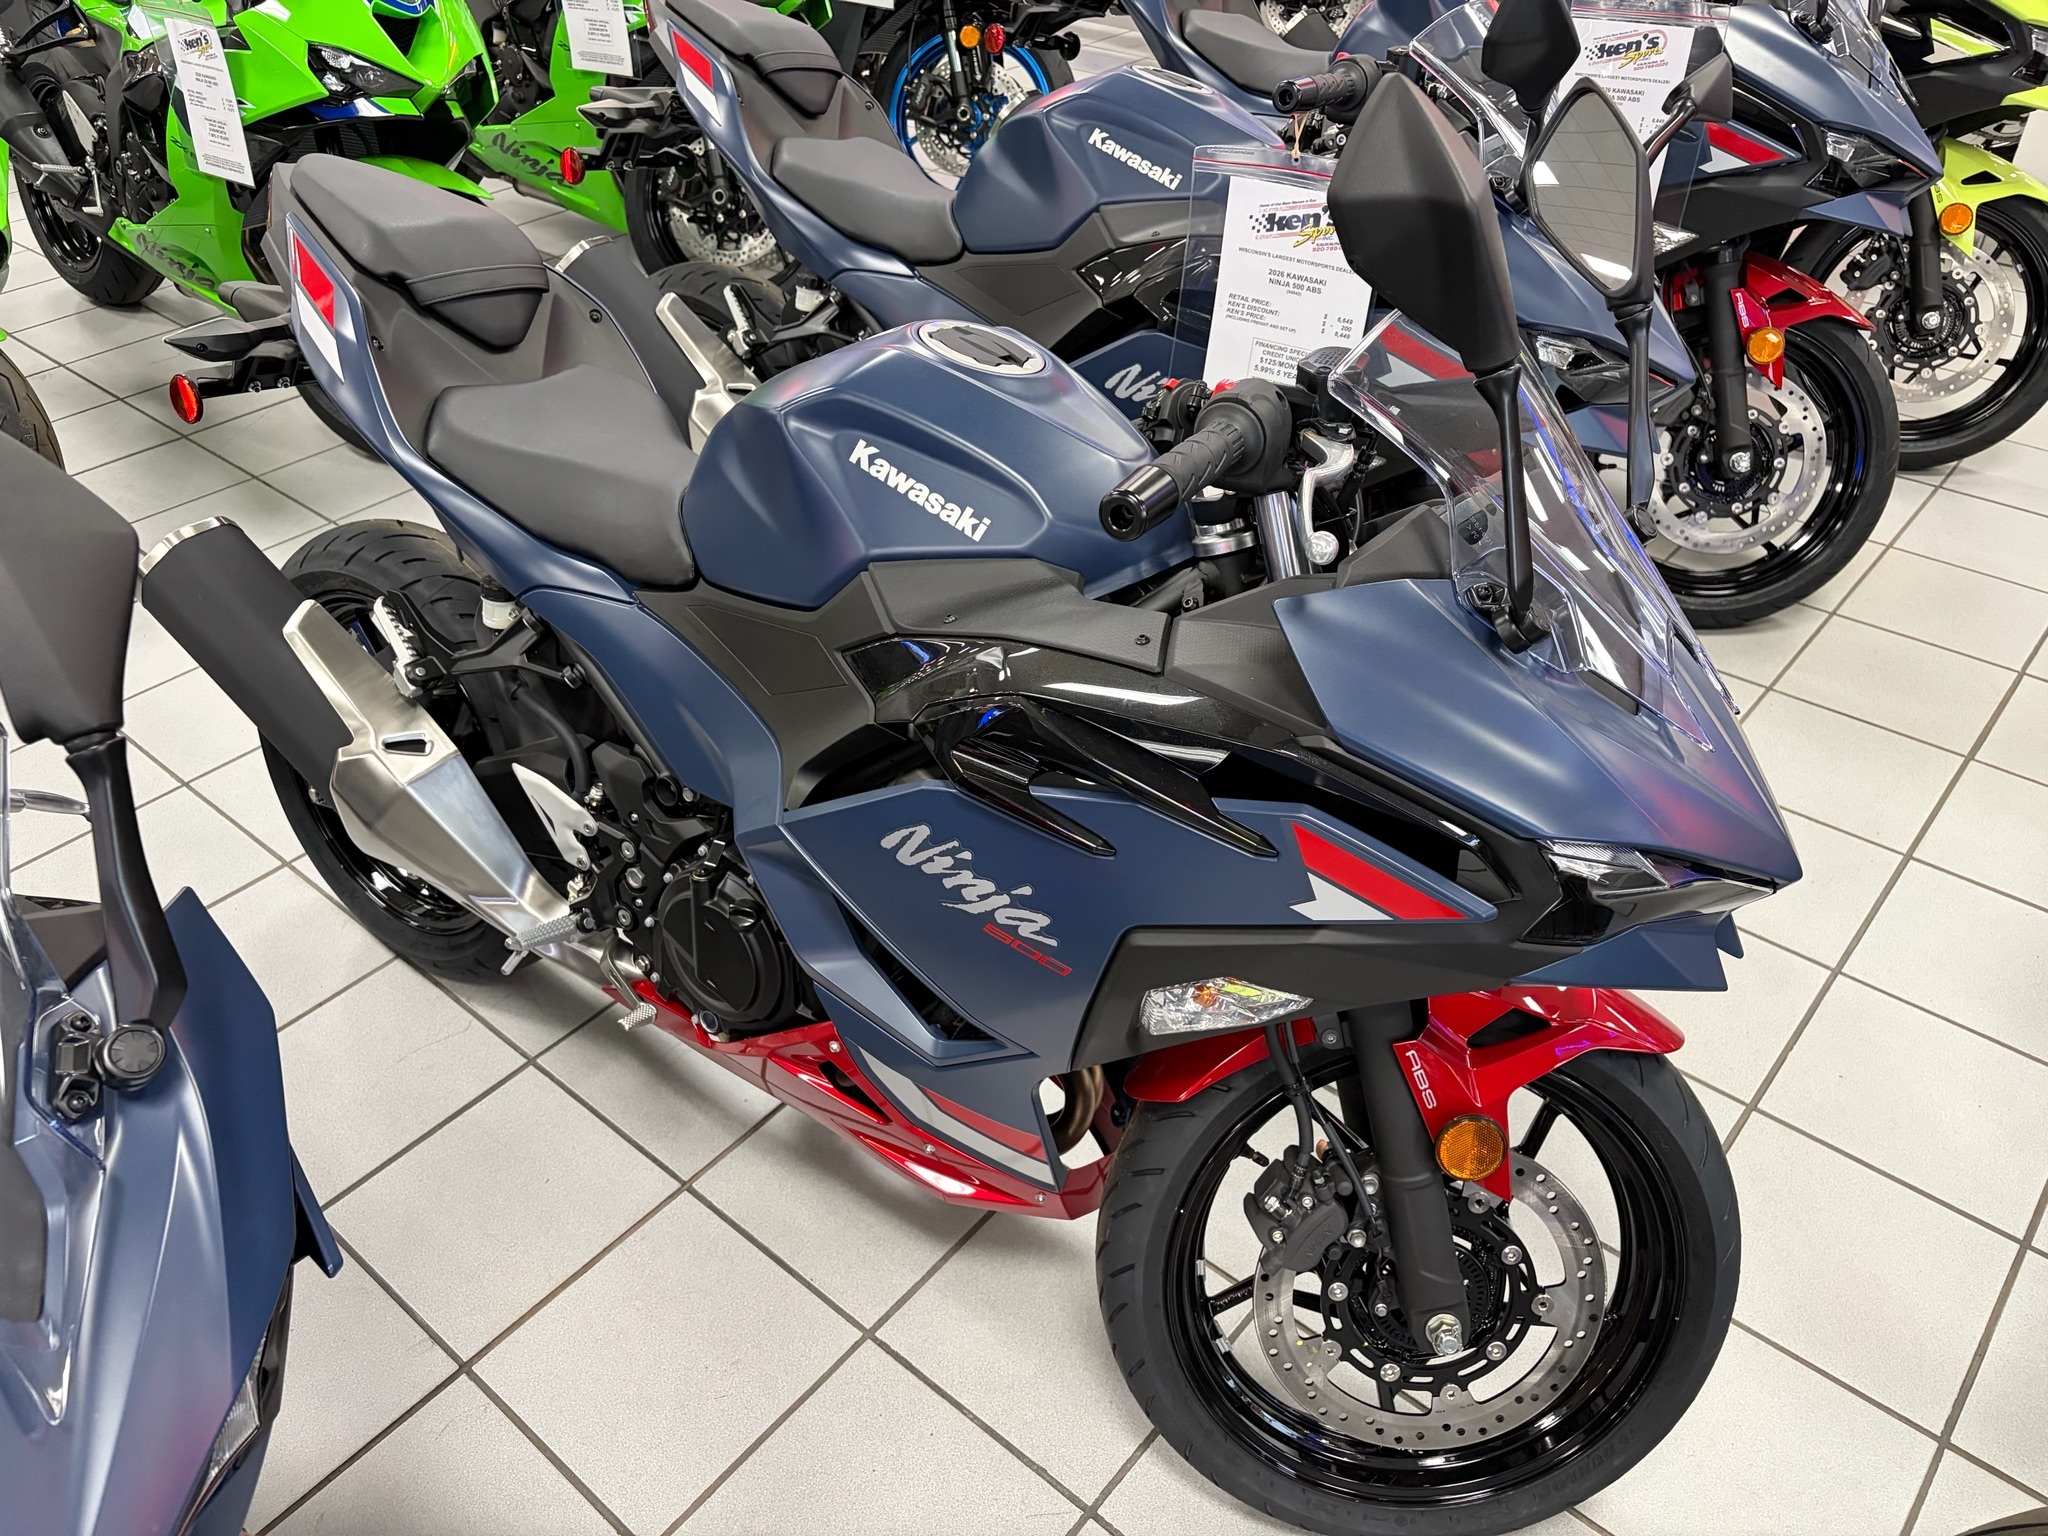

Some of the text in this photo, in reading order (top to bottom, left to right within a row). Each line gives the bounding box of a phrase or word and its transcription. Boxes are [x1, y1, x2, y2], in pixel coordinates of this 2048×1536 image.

[1597, 33, 1660, 59] ken's
[1618, 46, 1664, 69] Sports
[1620, 75, 1652, 83] MOTORSPORTS
[1612, 88, 1645, 96] KAWASAKI
[492, 132, 574, 189] Ninja
[1088, 128, 1183, 191] Kawasaki
[1934, 184, 1943, 203] BS
[1293, 223, 1335, 248] Spor
[136, 232, 215, 290] Ninja
[1238, 246, 1355, 275] WISCONSIN'S LARGEST MOTORSPORTS DEALE
[1268, 268, 1327, 287] 2026 KAWASAKI
[1268, 277, 1322, 295] NINJA 500 ABS
[1228, 293, 1272, 308] RETAIL PRICE:
[1228, 300, 1280, 317] KEN'S DISCOUNT:
[1735, 292, 1750, 328] ABS
[1226, 307, 1266, 321] KEN'S PRICE:
[1337, 316, 1354, 325] 6,649
[1225, 314, 1250, 324] (INCLUDING
[1250, 319, 1269, 328] FREIGHT
[1288, 326, 1296, 334] UP)
[1334, 331, 1351, 340] 6,449
[1255, 341, 1310, 356] FINANCING SPECI
[1262, 349, 1300, 363] CREDIT UNIO
[1254, 364, 1275, 376] 5.99%
[1260, 357, 1298, 370] $125/MON
[848, 438, 992, 542] Kawasaki
[880, 824, 1058, 947] Ninja
[983, 923, 1073, 977] 500
[1405, 1050, 1437, 1109] ABS
